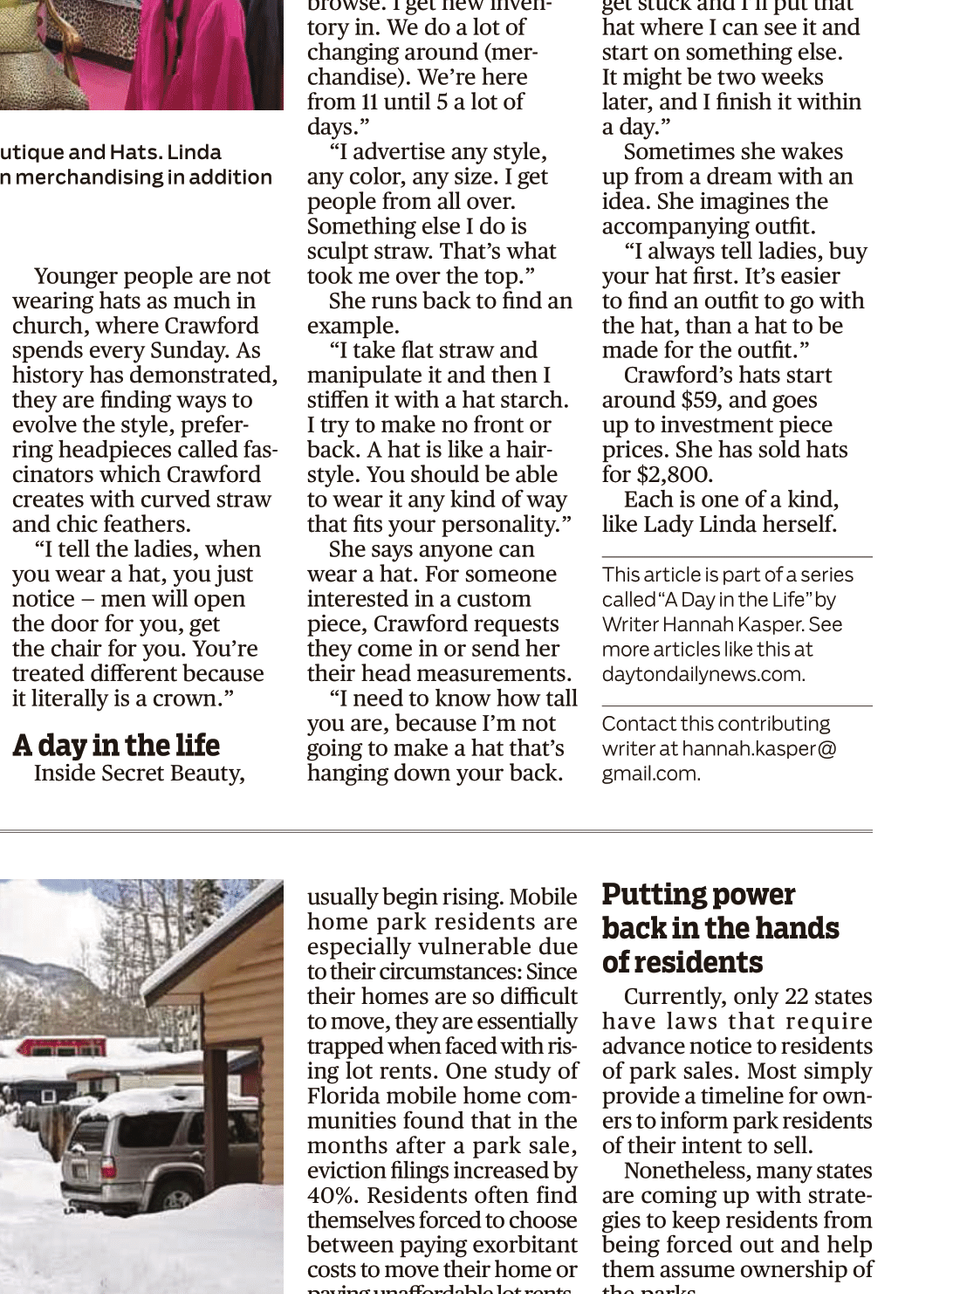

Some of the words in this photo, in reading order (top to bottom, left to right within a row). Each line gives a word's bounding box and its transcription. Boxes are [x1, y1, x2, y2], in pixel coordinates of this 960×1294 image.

[308, 117, 369, 140] days.”
[603, 514, 637, 532] like
[644, 514, 694, 537] Lady
[700, 514, 757, 532] Linda
[763, 514, 836, 532] herself.
[603, 666, 805, 685] daytondailynews.com.
[13, 734, 32, 756] A
[39, 733, 87, 761] day
[93, 733, 120, 756] in
[125, 733, 170, 756] the
[176, 733, 220, 756] life
[602, 765, 700, 784] gmail.com.
[602, 882, 708, 910] Putting
[713, 887, 796, 909] power
[602, 916, 667, 939] back
[672, 916, 700, 939] in
[705, 916, 750, 939] the
[756, 916, 839, 939] hands
[603, 950, 630, 973] of
[635, 950, 763, 973] residents
